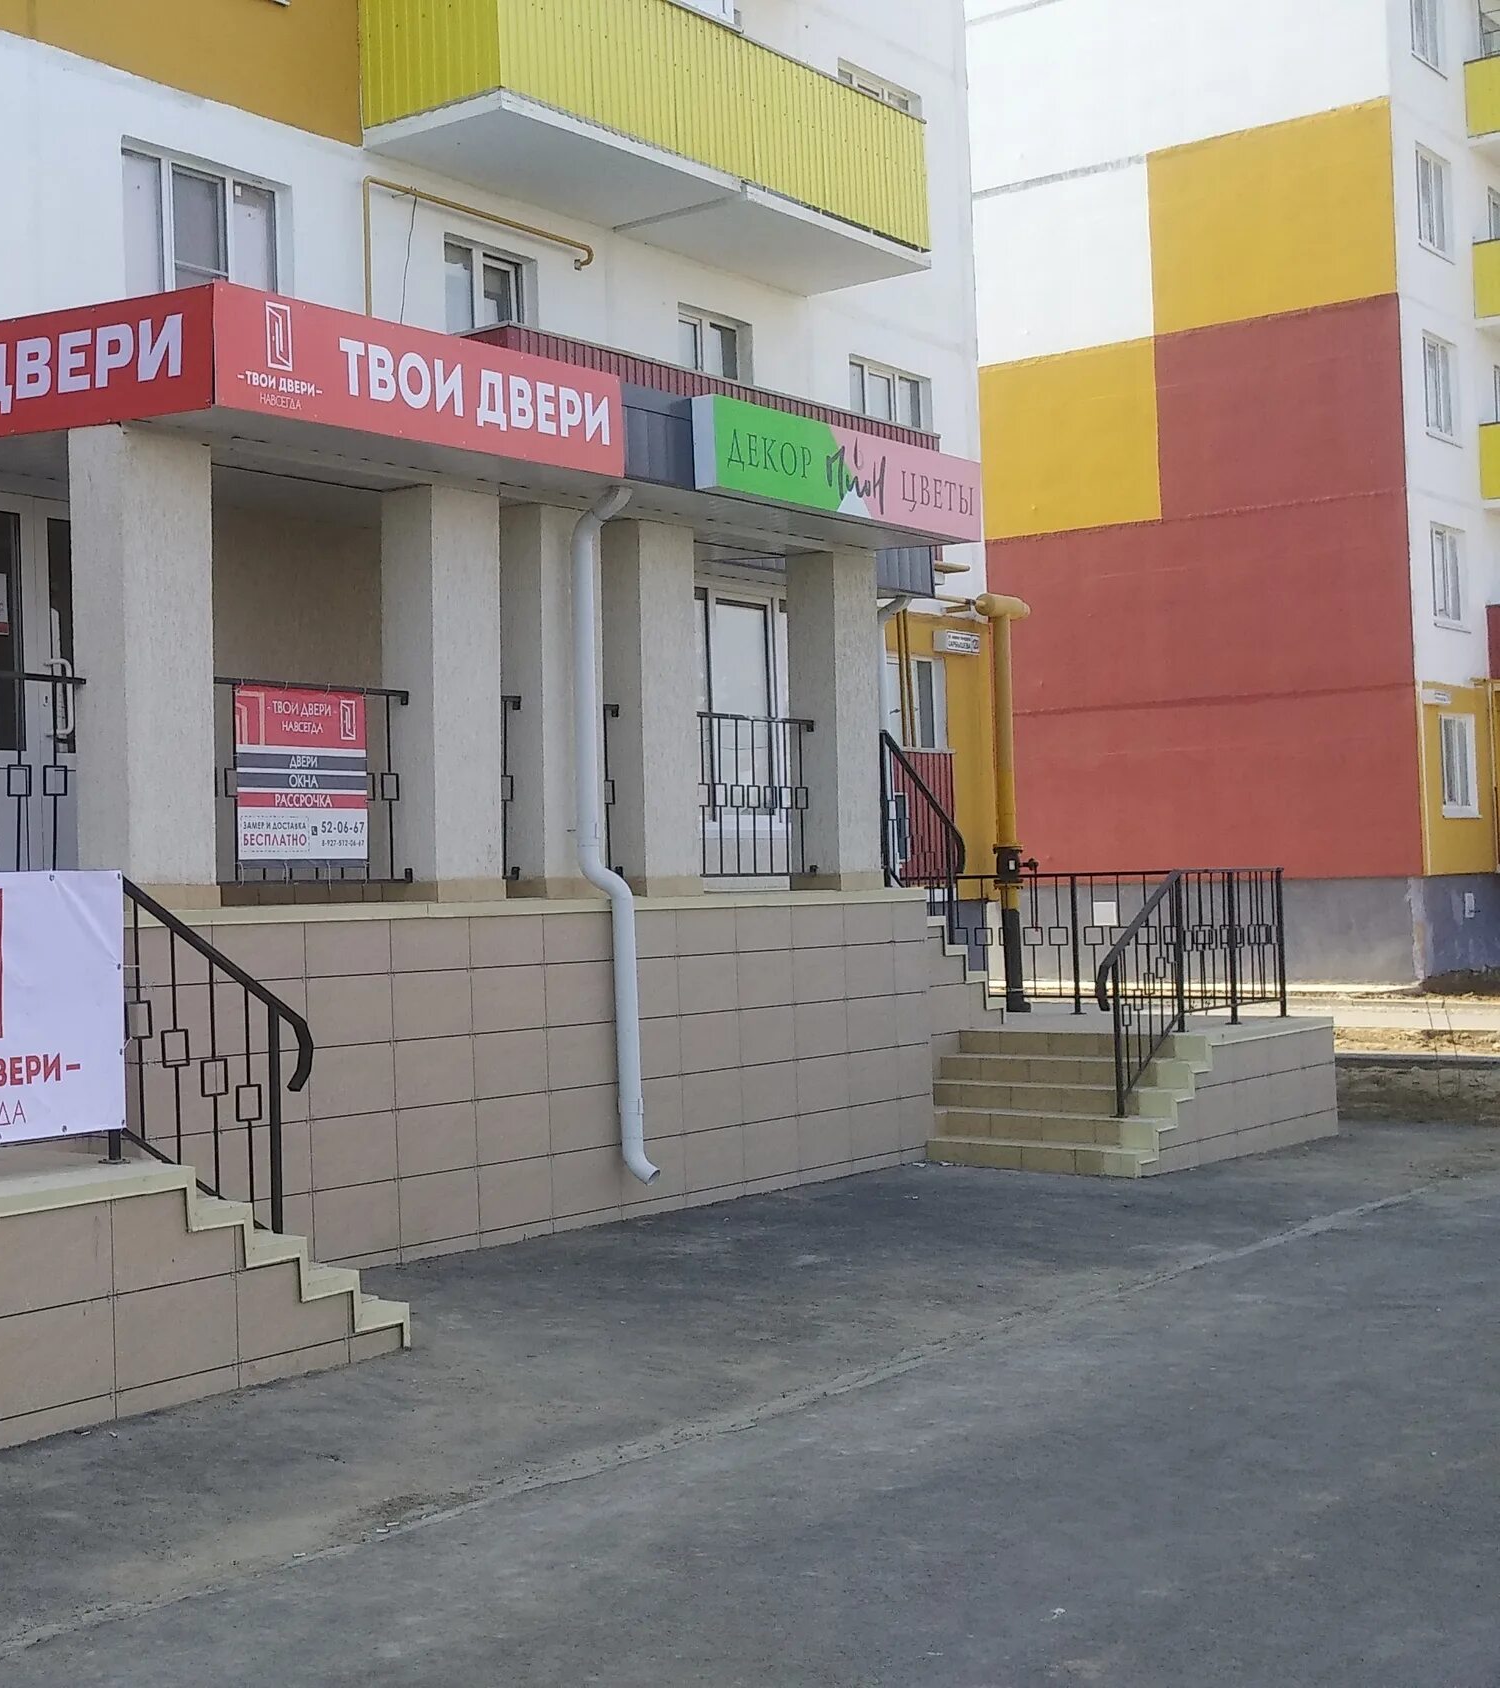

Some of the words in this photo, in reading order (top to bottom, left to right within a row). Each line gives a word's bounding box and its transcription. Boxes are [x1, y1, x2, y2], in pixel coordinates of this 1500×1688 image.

[339, 337, 464, 419] ТВОИ
[475, 369, 612, 447] ДВЕРИ
[260, 392, 302, 410] НАВСЕГДА
[727, 428, 812, 480] ДЕКОР
[901, 470, 974, 516] ЦВЕТЫ
[282, 721, 323, 734] НАВСЕГДА
[289, 756, 318, 768] ДВЕРИ
[288, 775, 319, 788] ОКНА
[275, 794, 333, 808] РАССРОЧКА
[243, 822, 265, 830] ЗАМЕР
[266, 822, 271, 830] И
[272, 822, 307, 831] ДОСТАВКА
[321, 821, 364, 834] 52-06-67
[243, 834, 307, 846] БЕСПЛАТНО
